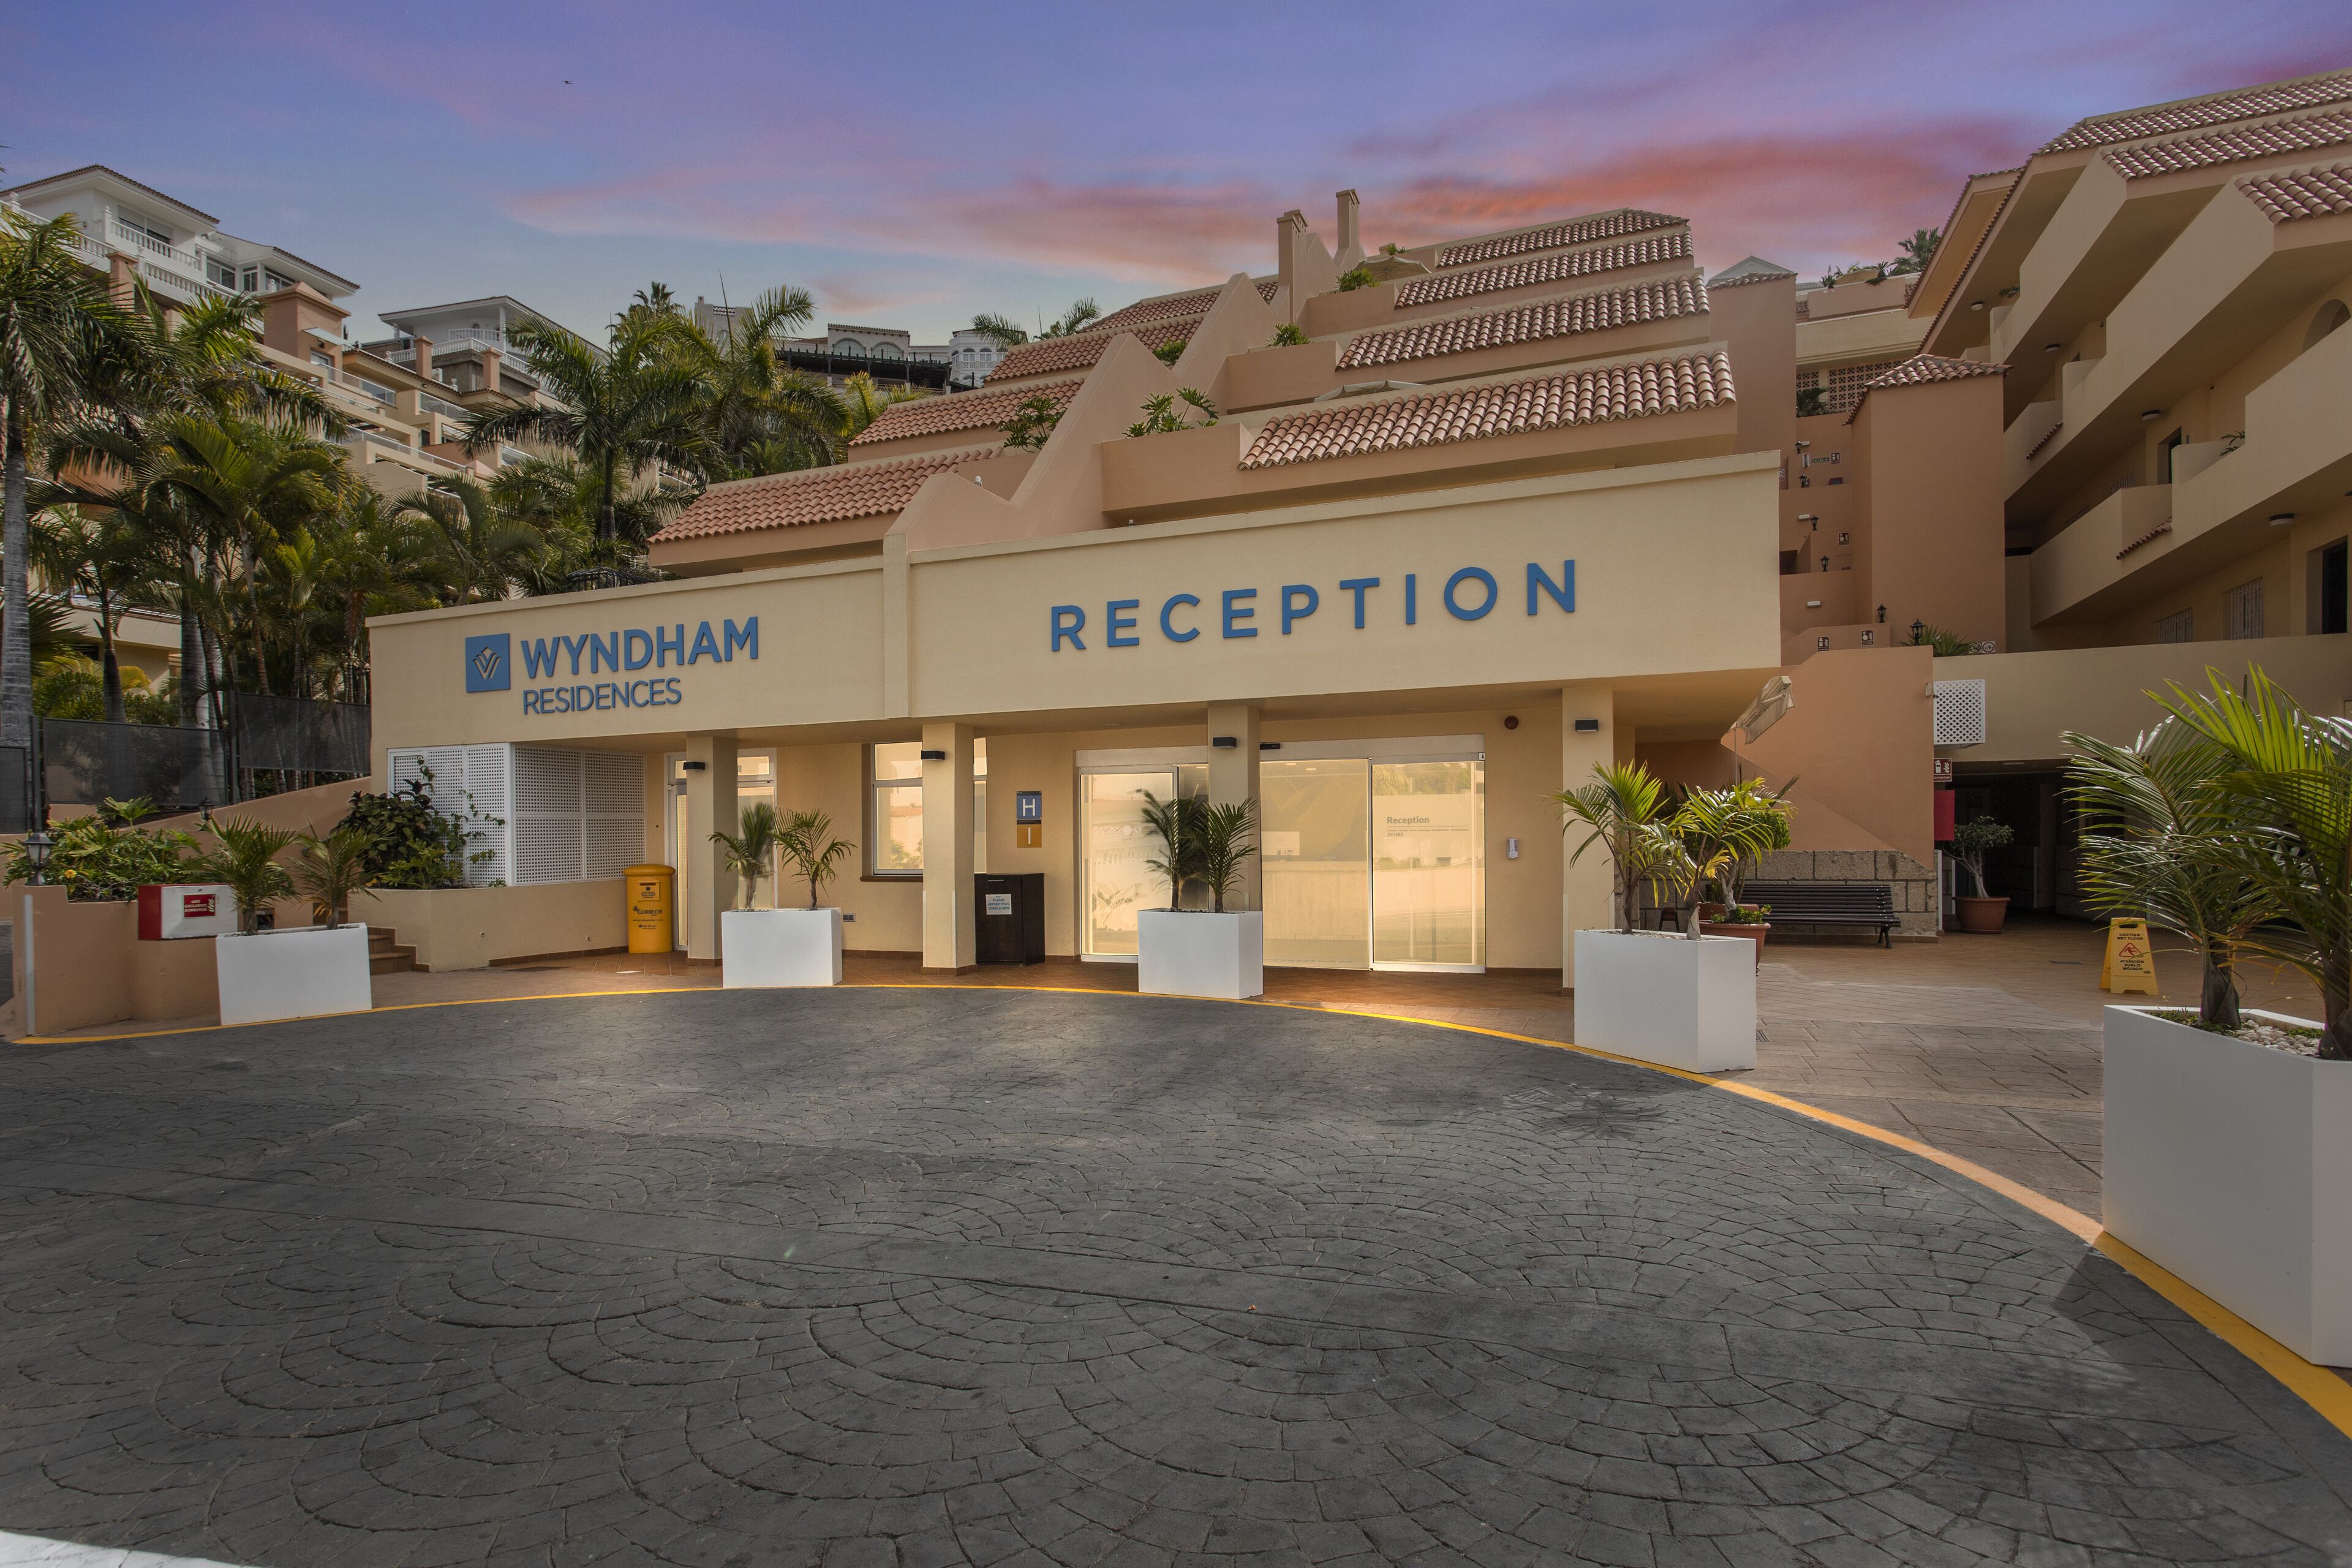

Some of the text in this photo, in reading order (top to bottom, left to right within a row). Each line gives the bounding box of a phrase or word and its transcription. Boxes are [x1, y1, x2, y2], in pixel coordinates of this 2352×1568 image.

[1051, 559, 1576, 652] RECEPTION
[521, 616, 758, 679] WYNDHAM
[523, 677, 682, 715] RESIDENCES
[1022, 799, 1036, 816] H
[1387, 816, 1430, 825] Reception
